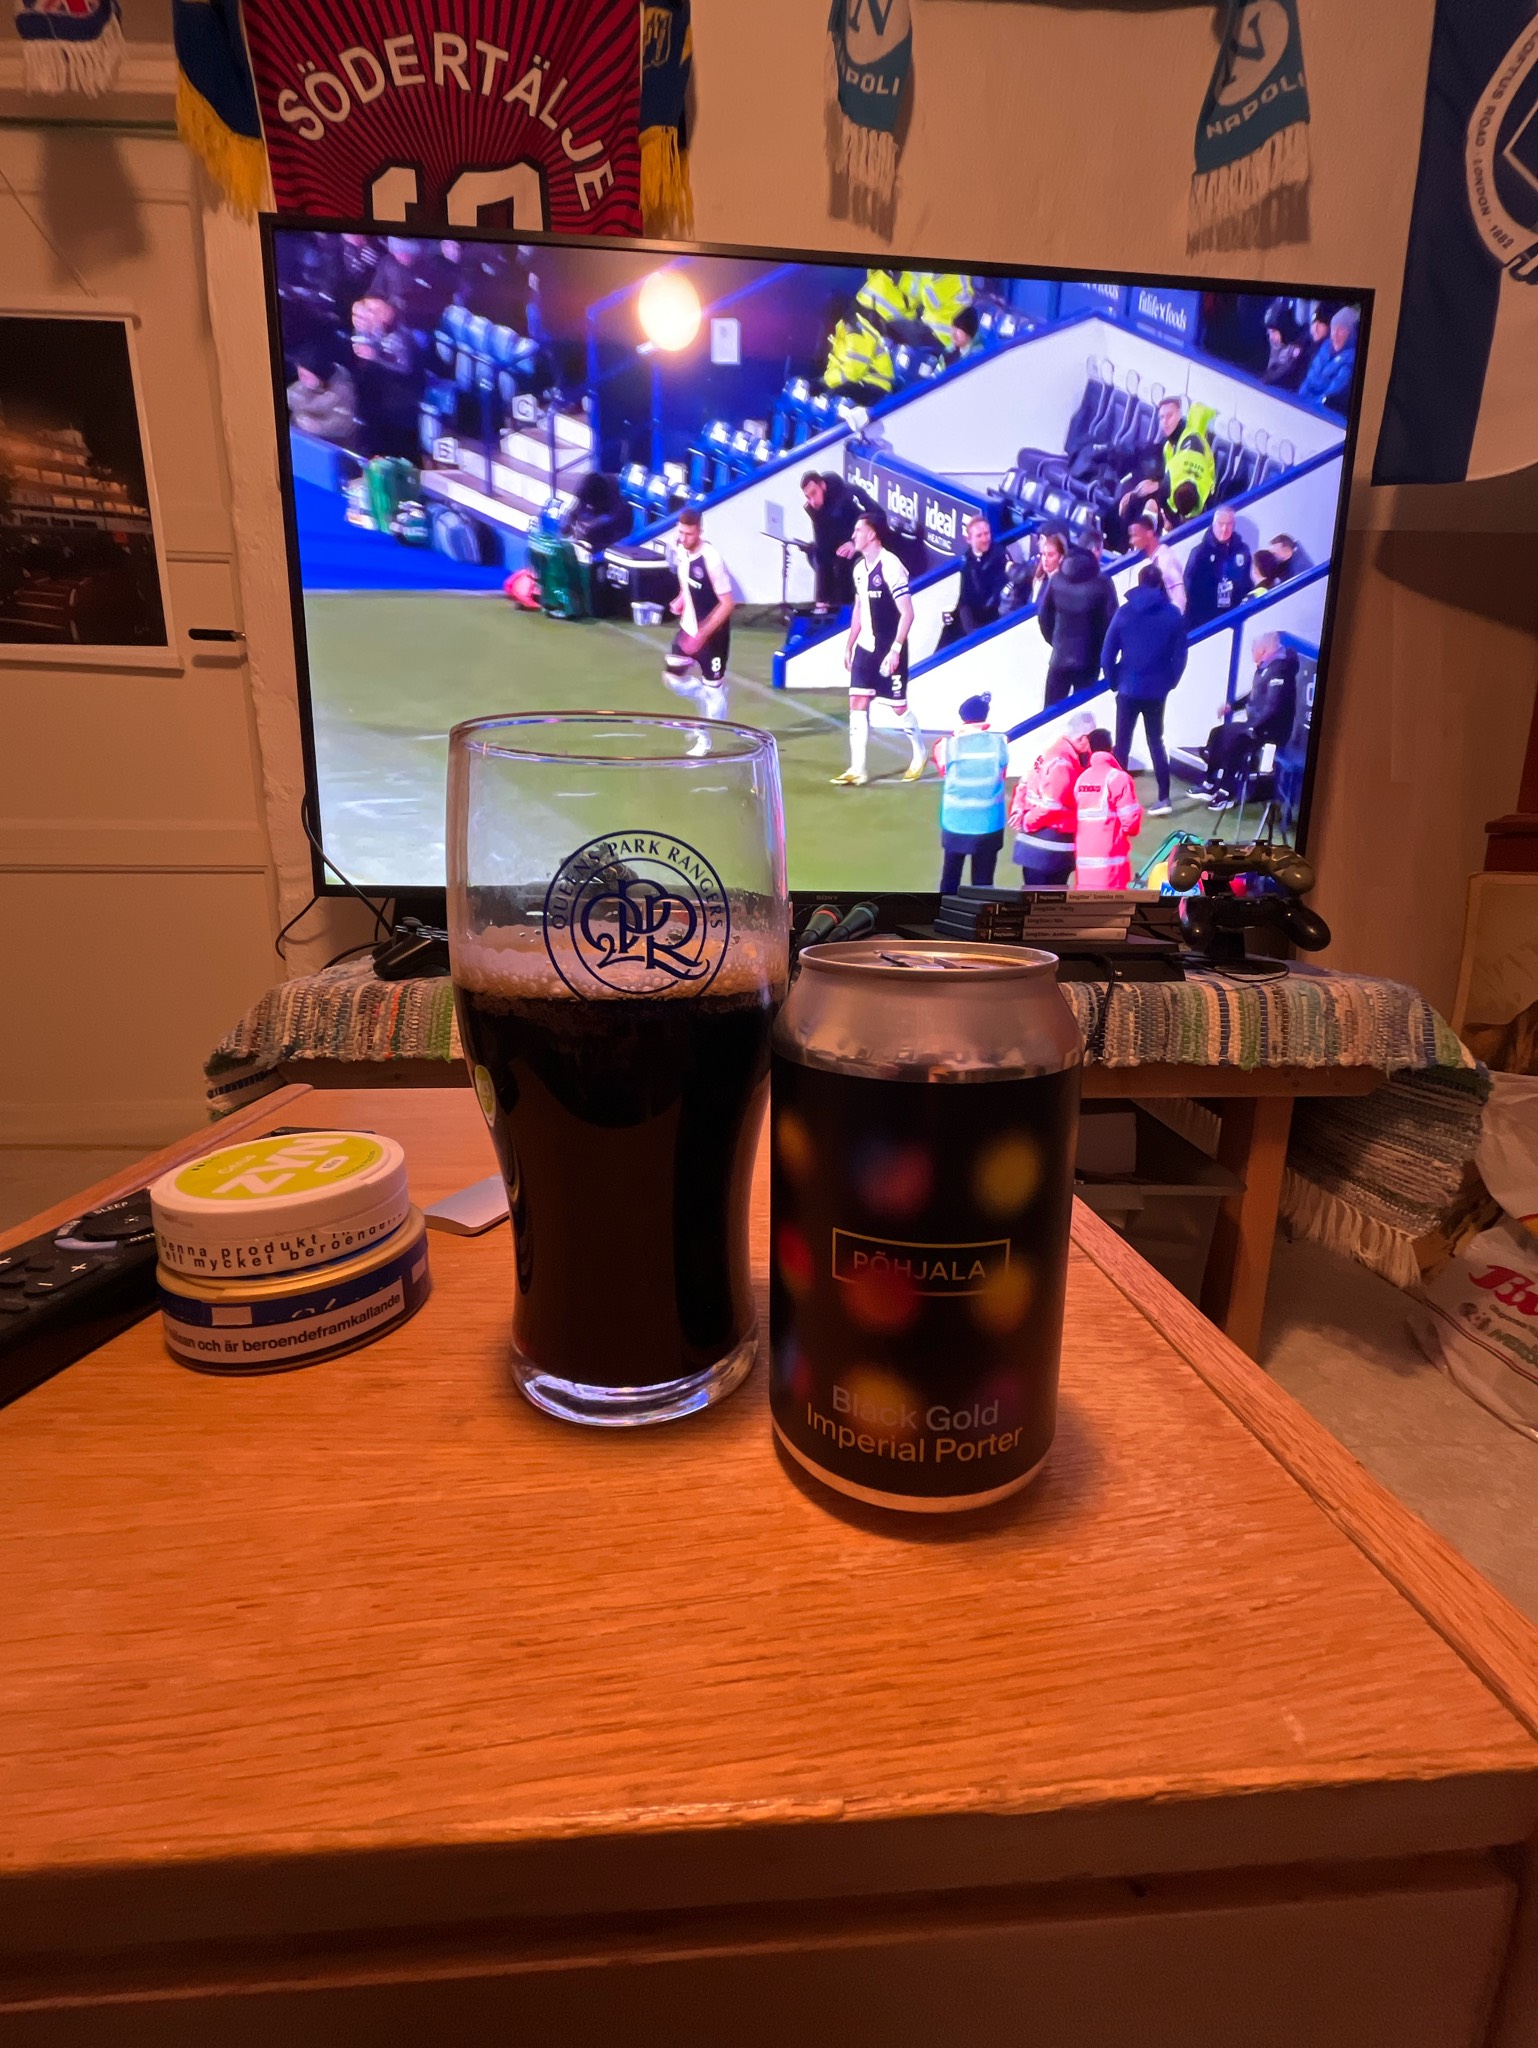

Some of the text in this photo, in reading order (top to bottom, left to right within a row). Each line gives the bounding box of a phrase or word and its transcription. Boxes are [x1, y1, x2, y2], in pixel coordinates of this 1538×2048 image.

[846, 66, 900, 96] POLI
[278, 32, 615, 212] SÖDERTÄLJE
[1206, 72, 1306, 139] NAPOLI
[1475, 105, 1496, 147] ROAD
[1473, 159, 1491, 217] LONDON
[1489, 225, 1515, 250] 1882
[887, 481, 919, 522] ideal
[925, 497, 957, 540] ideal
[711, 657, 722, 672] 8
[891, 675, 902, 691] 3
[552, 838, 724, 930] QUEENS PARK RANGERS
[211, 1138, 349, 1194] ZYN
[93, 1201, 129, 1214] SLEEP
[161, 1234, 317, 1260] Denna produkt
[194, 1254, 273, 1272] mycket
[853, 1249, 986, 1281] PÕHJALA
[198, 1340, 221, 1353] och
[224, 1340, 238, 1353] är
[242, 1294, 400, 1352] beroendeframkallande
[833, 1384, 999, 1432] Black Gold
[807, 1402, 1023, 1463] Imperial Porter
